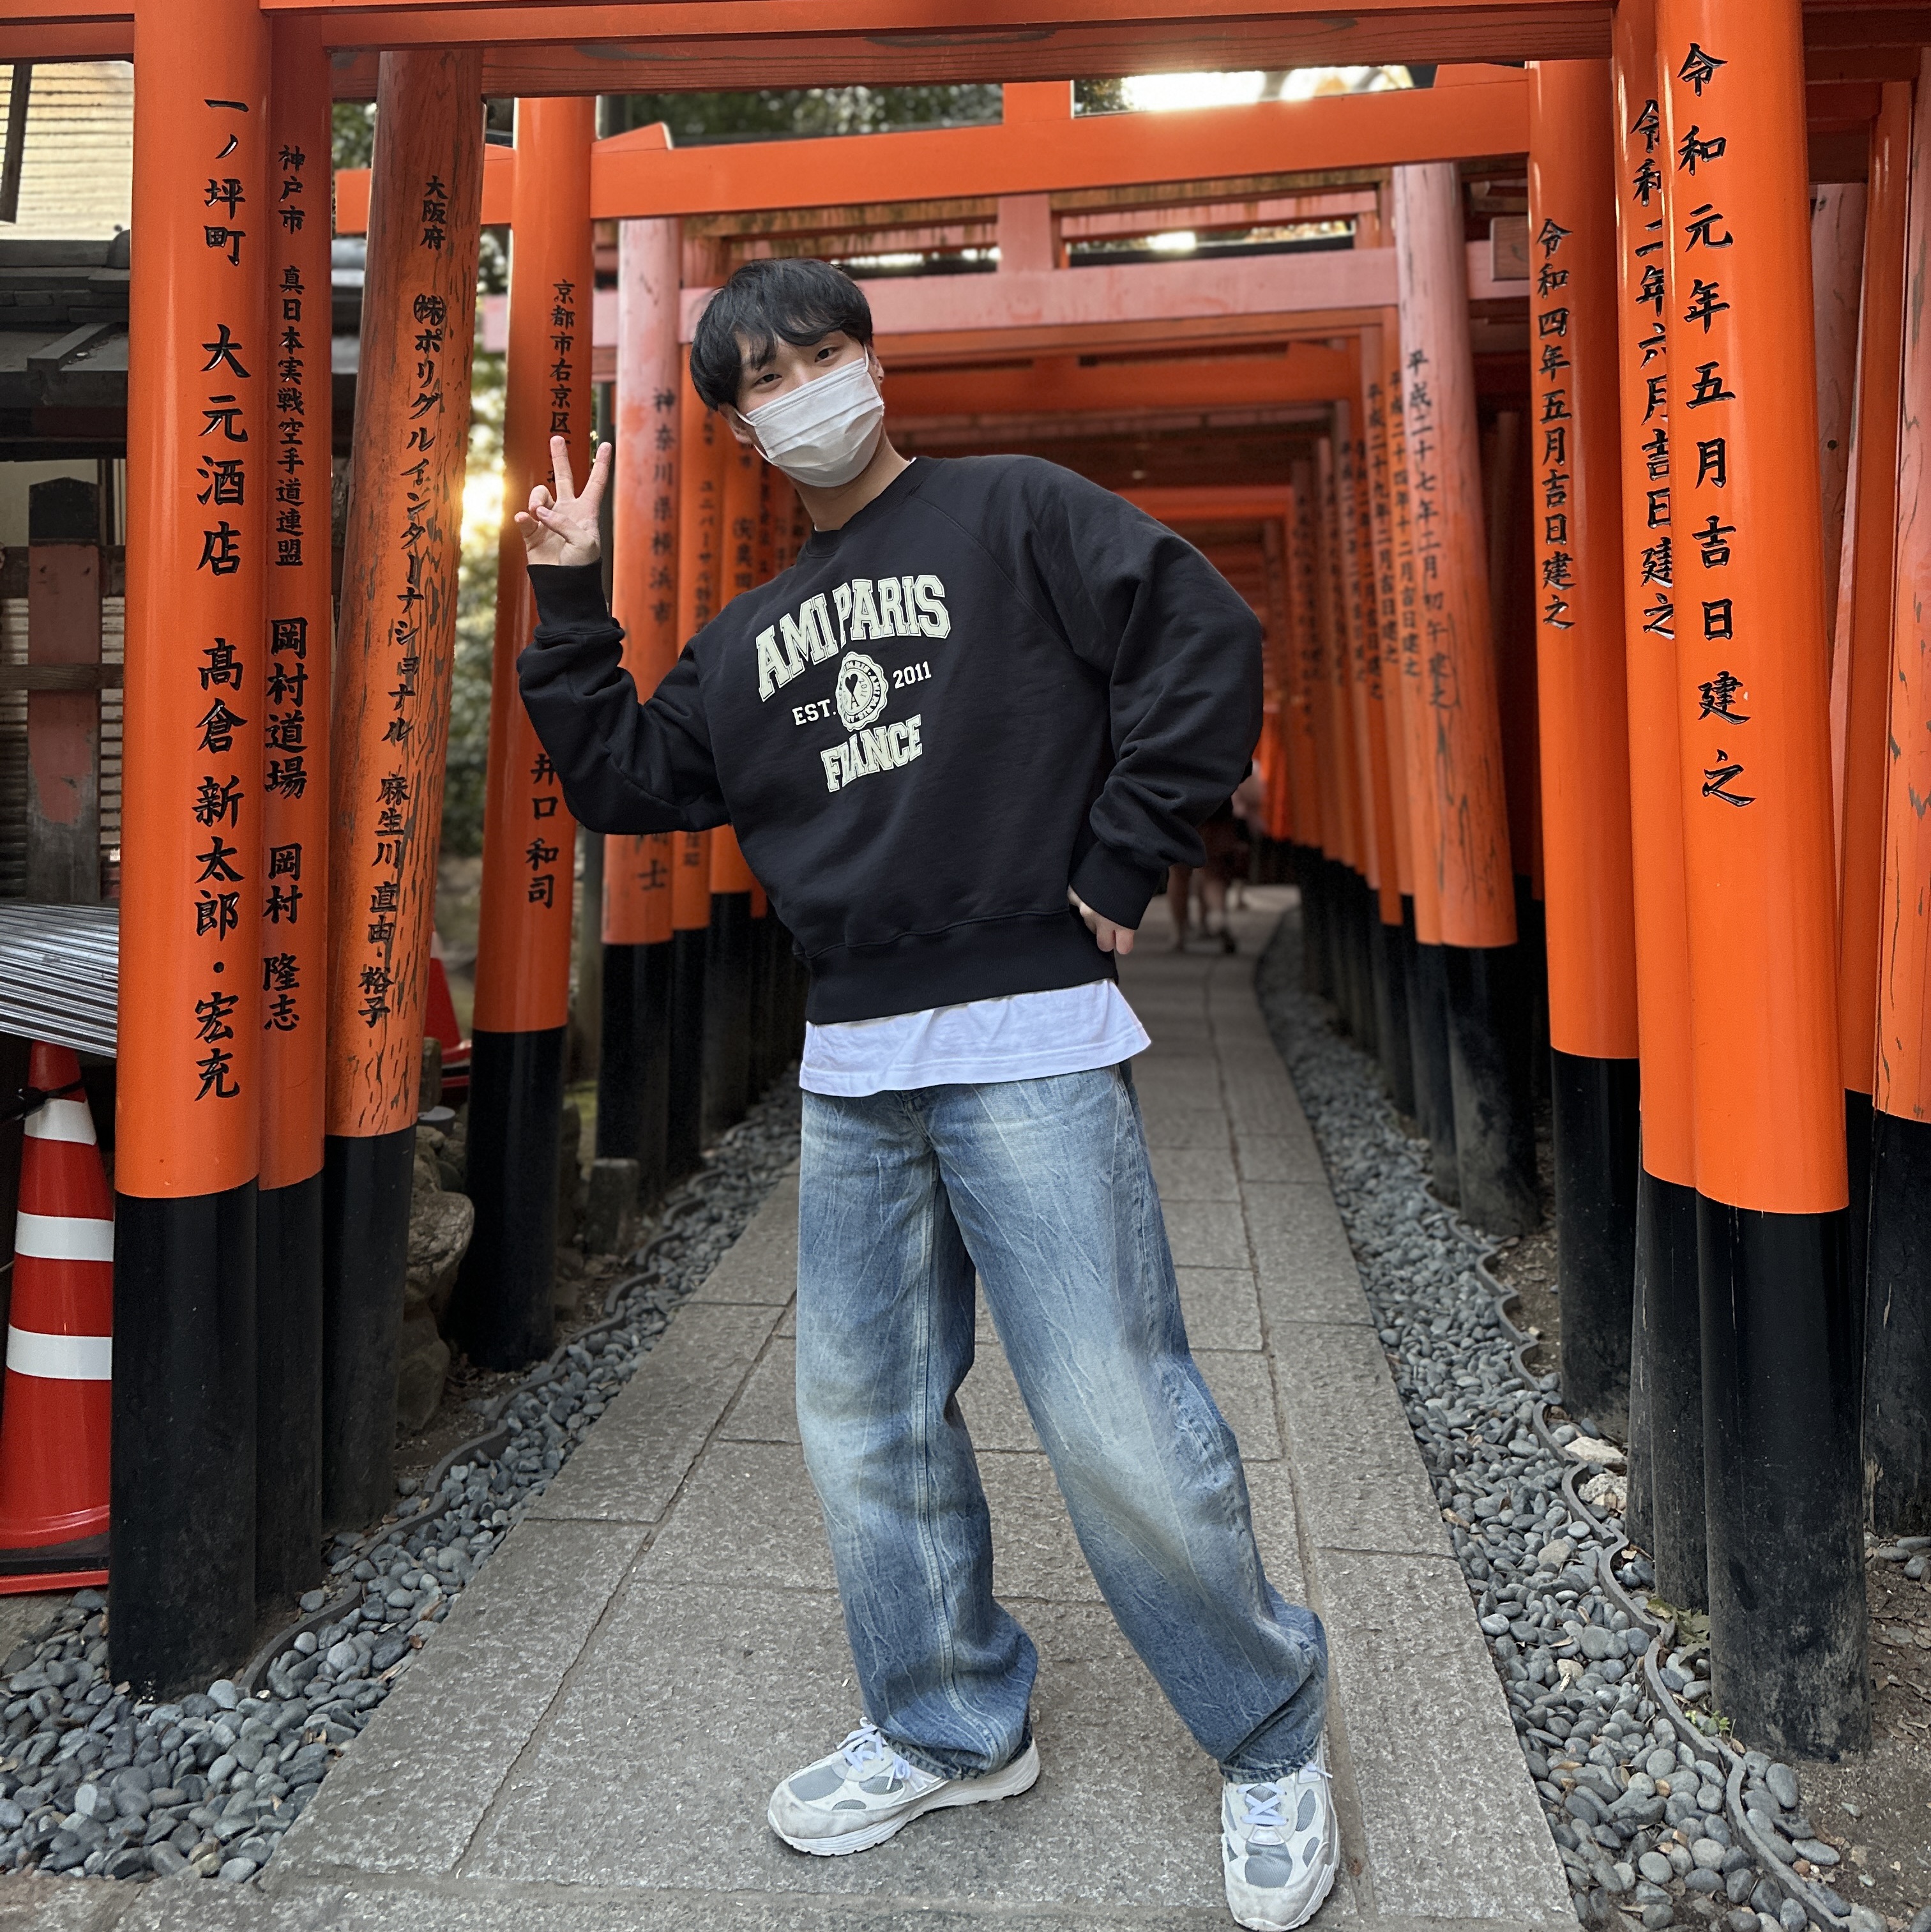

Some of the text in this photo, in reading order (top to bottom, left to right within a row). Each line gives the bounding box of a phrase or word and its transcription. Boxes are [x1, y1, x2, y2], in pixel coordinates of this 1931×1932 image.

[204, 98, 250, 267] 一ノ坪町
[276, 144, 307, 234] 神戸市
[420, 174, 448, 251] 大阪府
[195, 323, 252, 577] 大元酒店
[274, 264, 306, 568] 真日本実戦空手道連盟
[1536, 218, 1577, 630] 令和四年五月吉日建之
[1677, 42, 1757, 807] 令和元年五月吉日建之
[263, 616, 309, 800] 岡村道場
[755, 574, 951, 702] AMI PARIS
[792, 661, 932, 726] EST. 2011
